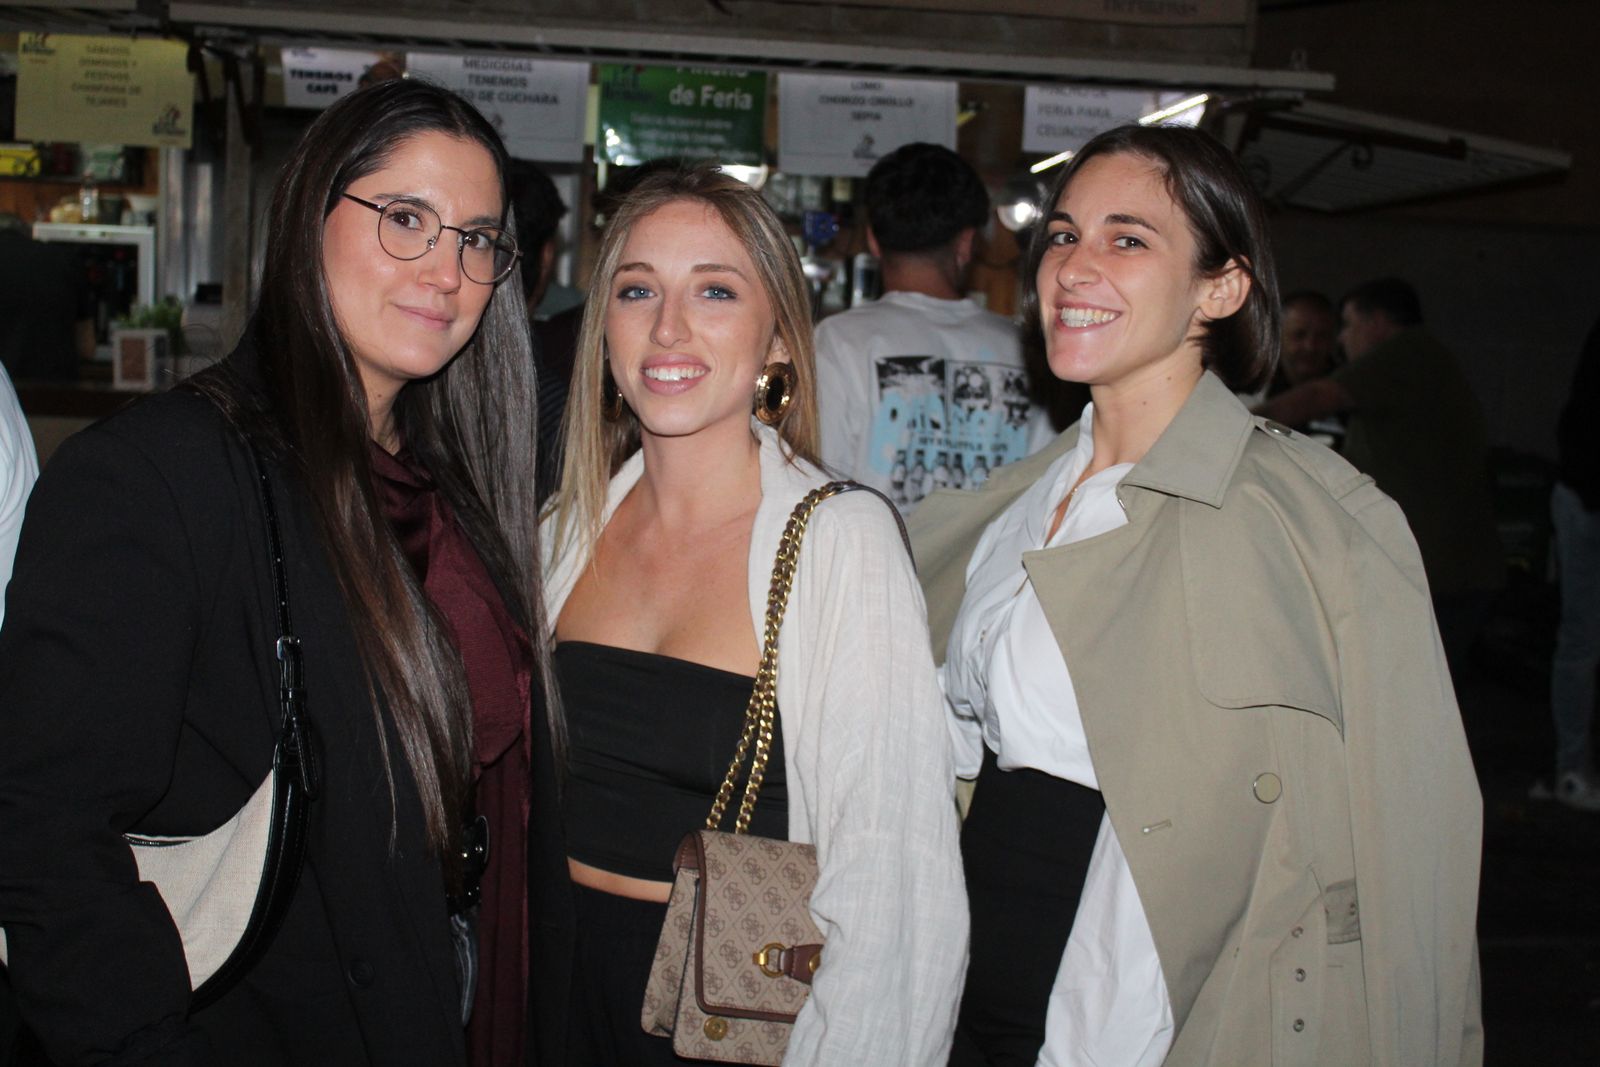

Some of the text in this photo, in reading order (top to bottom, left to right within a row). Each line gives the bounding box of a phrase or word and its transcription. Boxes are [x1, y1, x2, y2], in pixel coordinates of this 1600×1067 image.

[290, 69, 352, 81] TENEMOS
[468, 74, 528, 88] TENEMOS
[498, 91, 559, 104] CUCHARA
[668, 83, 695, 107] de
[700, 85, 753, 110] Feria
